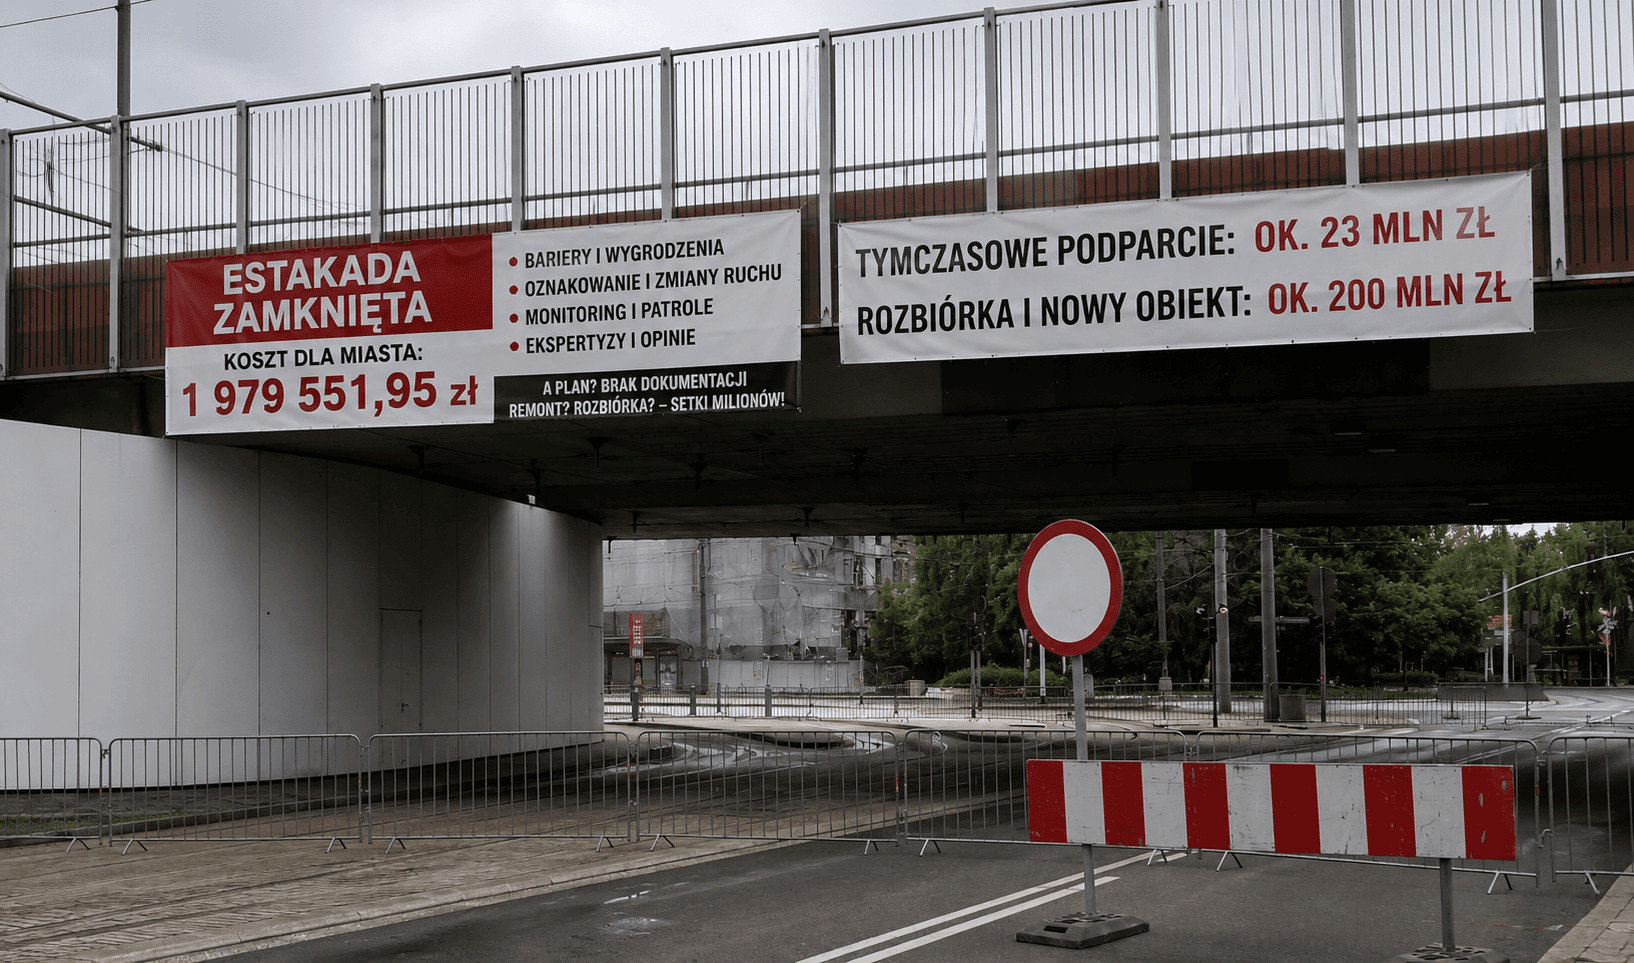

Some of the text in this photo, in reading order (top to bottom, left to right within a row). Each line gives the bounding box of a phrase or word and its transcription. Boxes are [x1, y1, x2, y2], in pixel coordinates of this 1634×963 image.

[1254, 205, 1496, 253] OK. 23 MLN ZŁ
[525, 238, 725, 269] BARIERY I WYGRODZENIA
[855, 224, 1235, 278] TYMCZASOWE PODPARCIE:
[224, 251, 421, 295] ESTAKADA
[525, 263, 782, 297] OZNAKOWANIE I ZMIANY RUCHU
[213, 290, 433, 333] ZAMKNIĘTA
[525, 297, 714, 326] MONITORING I PATROLE
[857, 285, 1251, 336] ROZBIÓRKA I NOWY OBIEKT:
[1268, 270, 1512, 315] OK. 200 MLN ZŁ
[224, 342, 423, 371] KOSZT DLA MIASTA:
[526, 328, 696, 354] EKSPERTYZY I OPINIE
[182, 370, 479, 418] 1 979 551,95 zł
[542, 370, 747, 396] A PLAN? BRAK DOKUMENTACJI
[509, 401, 570, 419] REMONT?
[573, 395, 655, 416] ROZBIÓRKA?
[670, 395, 708, 412] SETKI
[712, 388, 785, 410] MILIONÓW!
